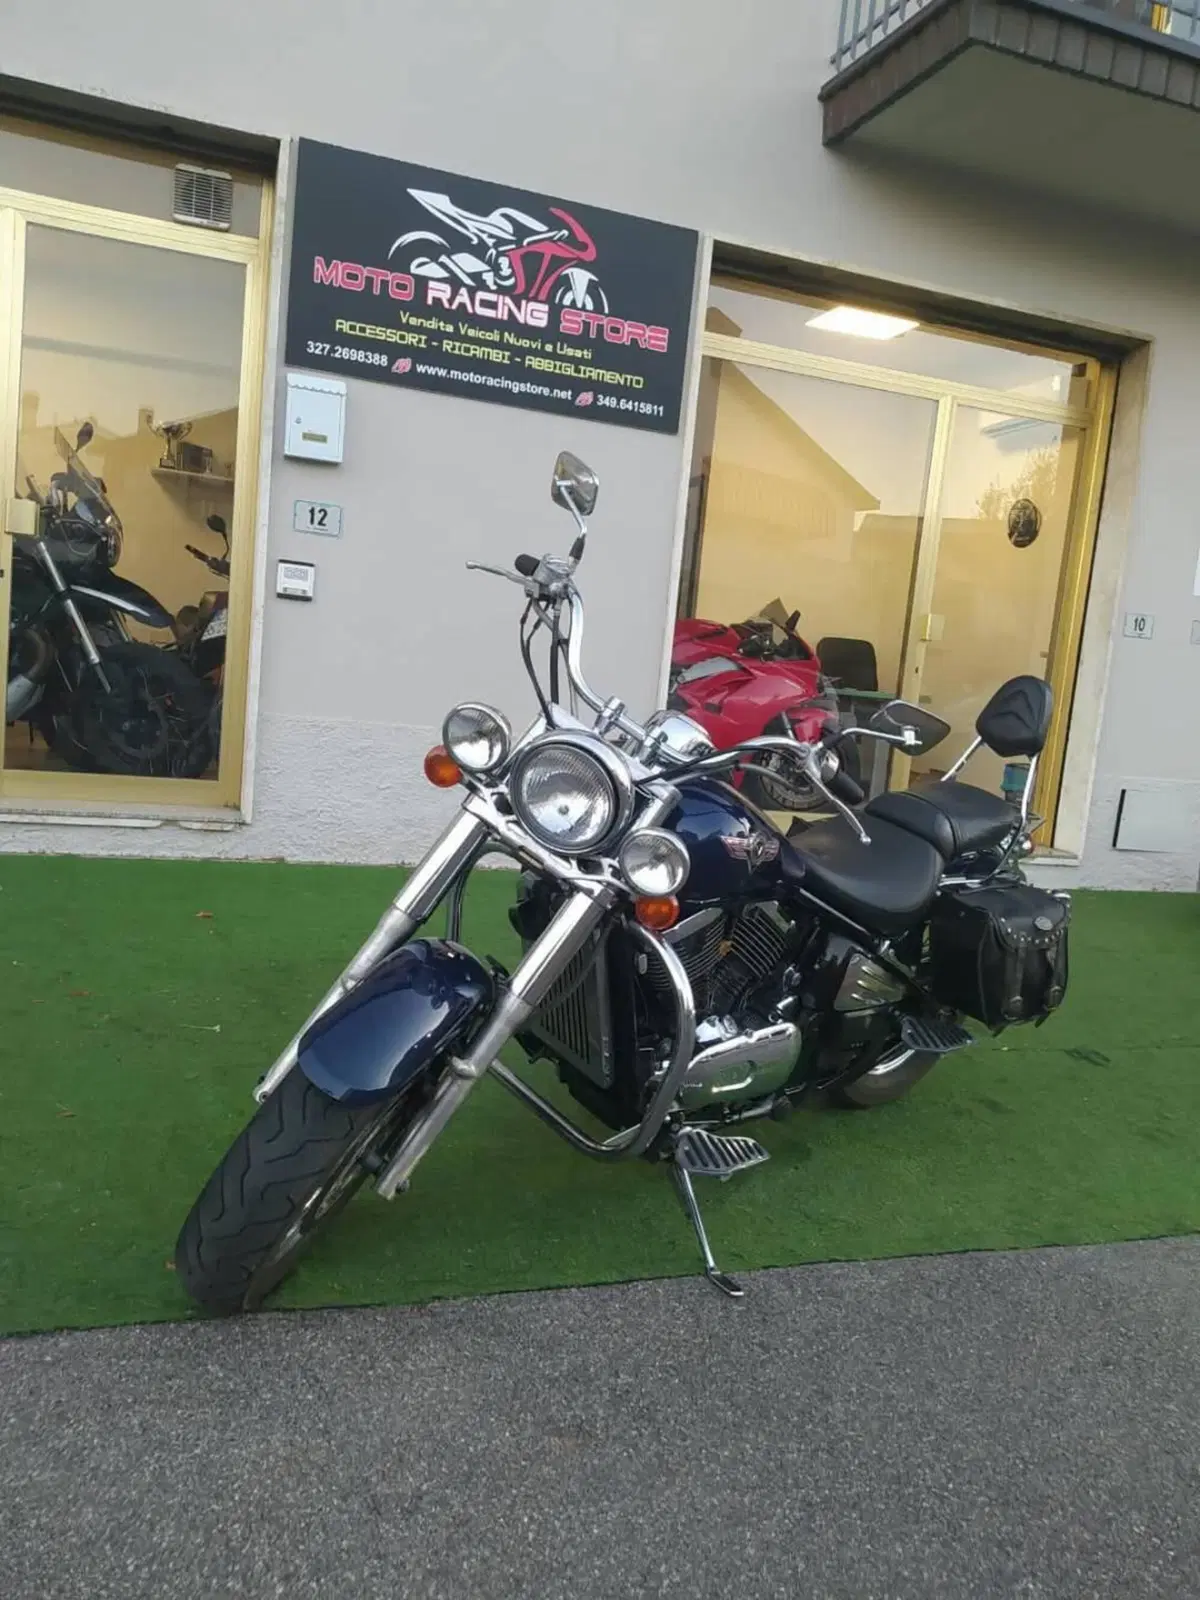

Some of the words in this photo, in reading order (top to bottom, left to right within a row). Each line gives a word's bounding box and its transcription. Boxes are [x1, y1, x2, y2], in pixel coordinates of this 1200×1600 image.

[313, 256, 415, 301] MOTO
[426, 280, 550, 328] RACING
[559, 308, 670, 353] STORE
[335, 319, 428, 348] ACCESSORI
[442, 339, 511, 365] RICAMBI
[524, 355, 644, 389] ABBIGLIAMENTO
[400, 310, 454, 333] Vendita
[458, 322, 501, 343] Veicoli
[503, 332, 541, 350] Nuovi
[556, 342, 593, 360] Usati
[306, 340, 389, 367] 327.2698388
[416, 362, 573, 401] www.motoracingstore.net
[596, 394, 664, 417] 349.6415811
[309, 507, 328, 526] 12
[1134, 617, 1145, 632] 10
